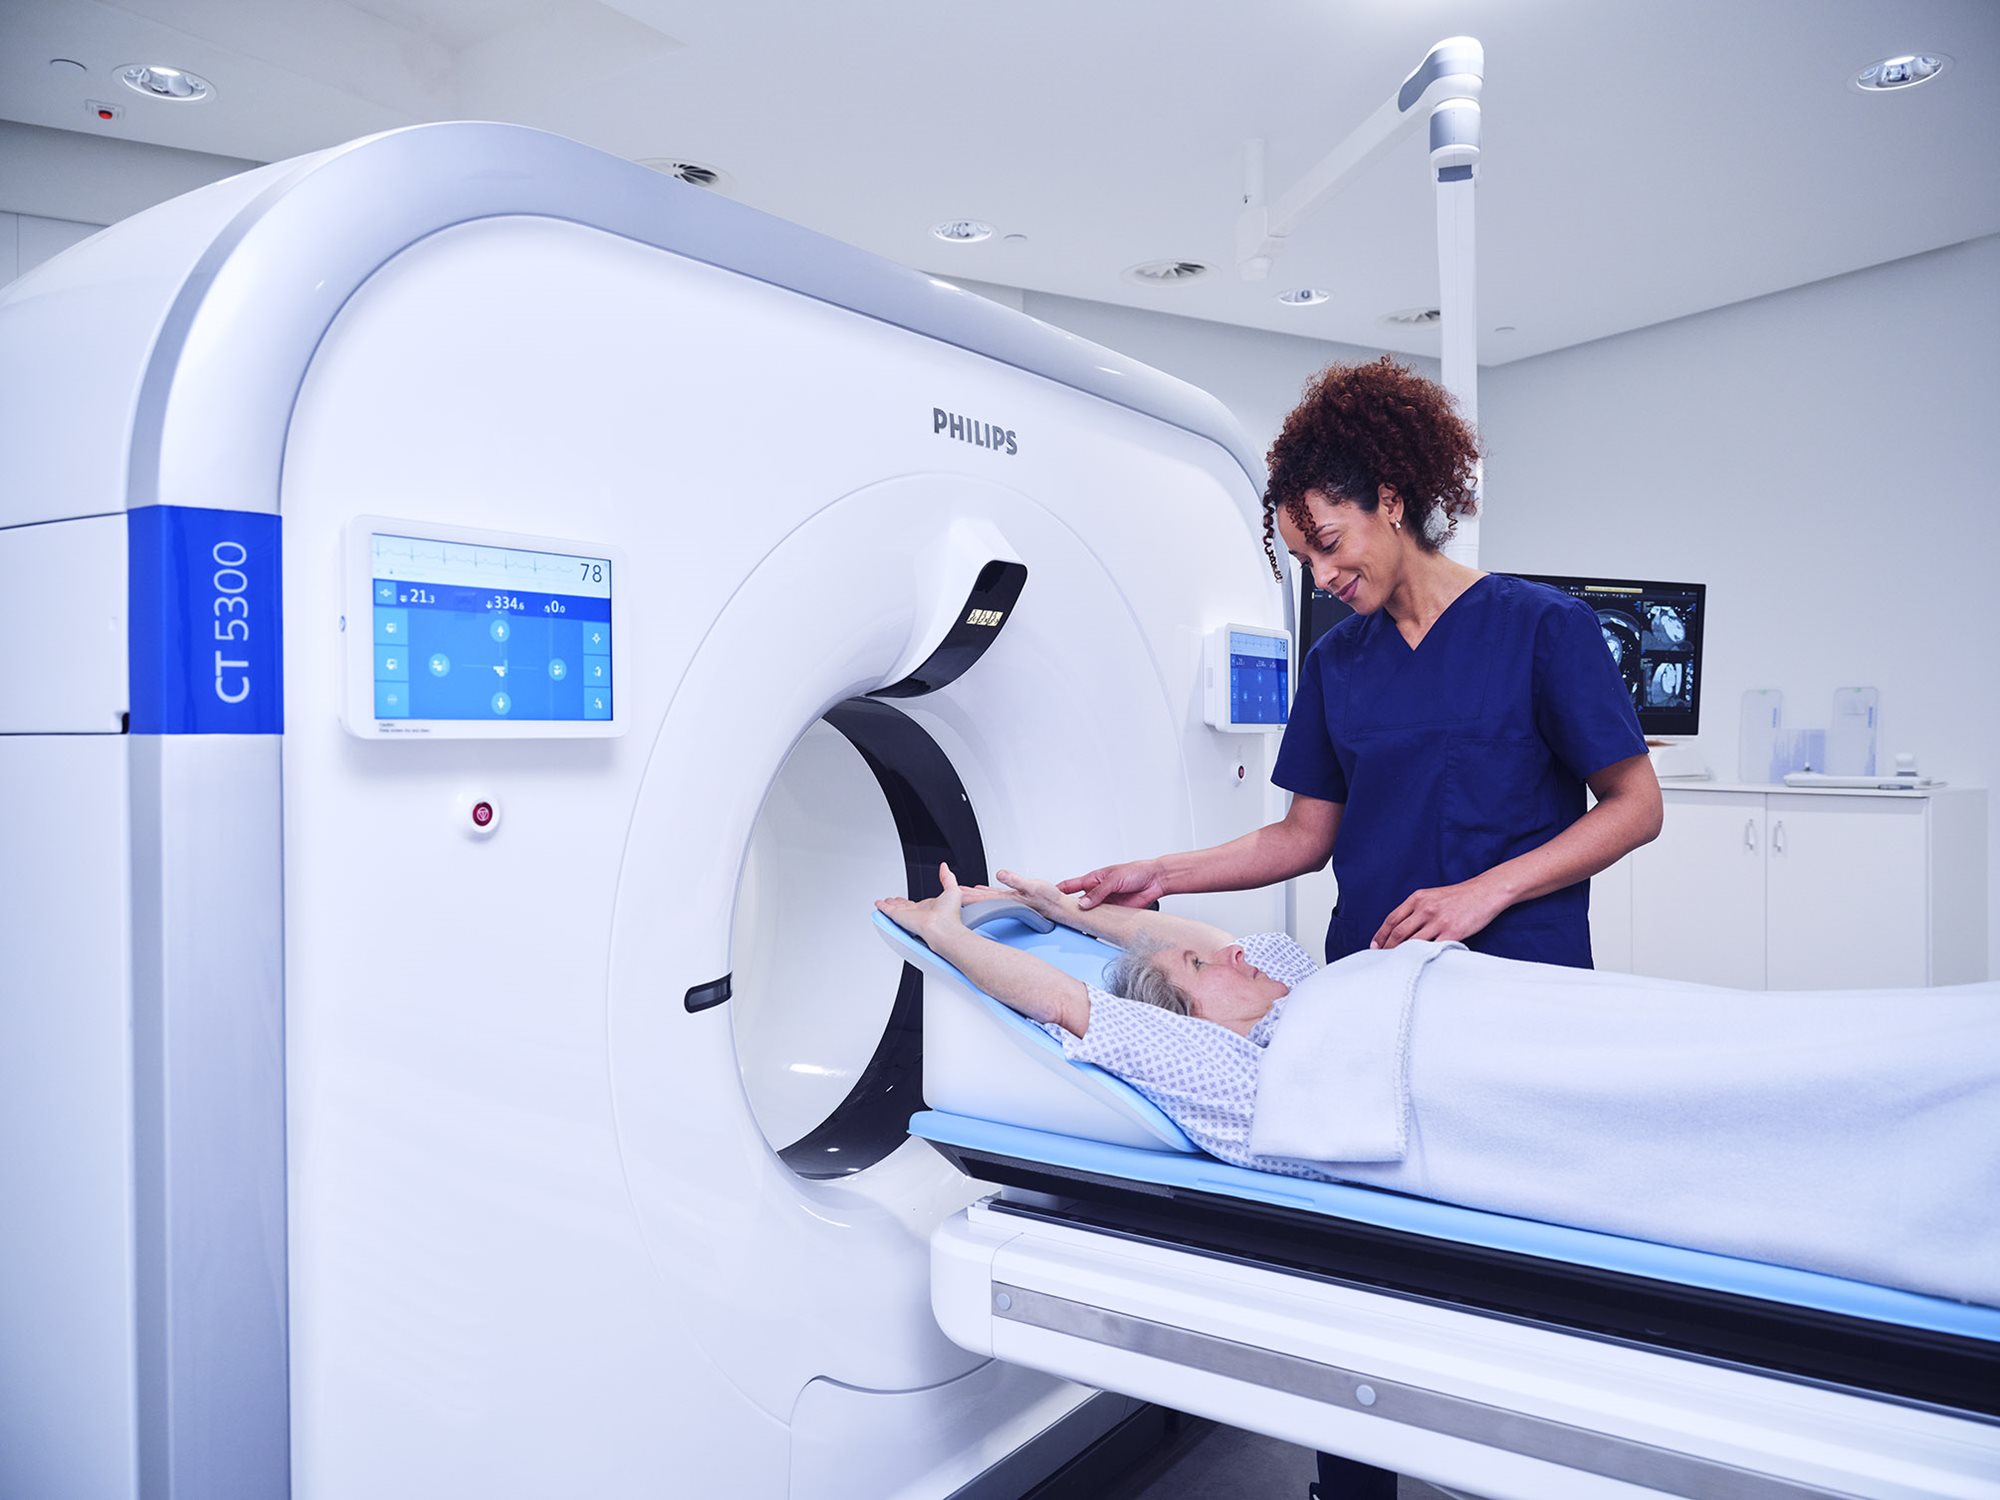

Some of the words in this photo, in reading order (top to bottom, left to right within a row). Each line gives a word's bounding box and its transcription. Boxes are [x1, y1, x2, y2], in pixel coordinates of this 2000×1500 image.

[933, 407, 1018, 456] PHILIPS
[212, 541, 249, 641] 5300
[580, 563, 602, 583] 78
[494, 595, 525, 611] 334.6
[215, 650, 250, 703] CT
